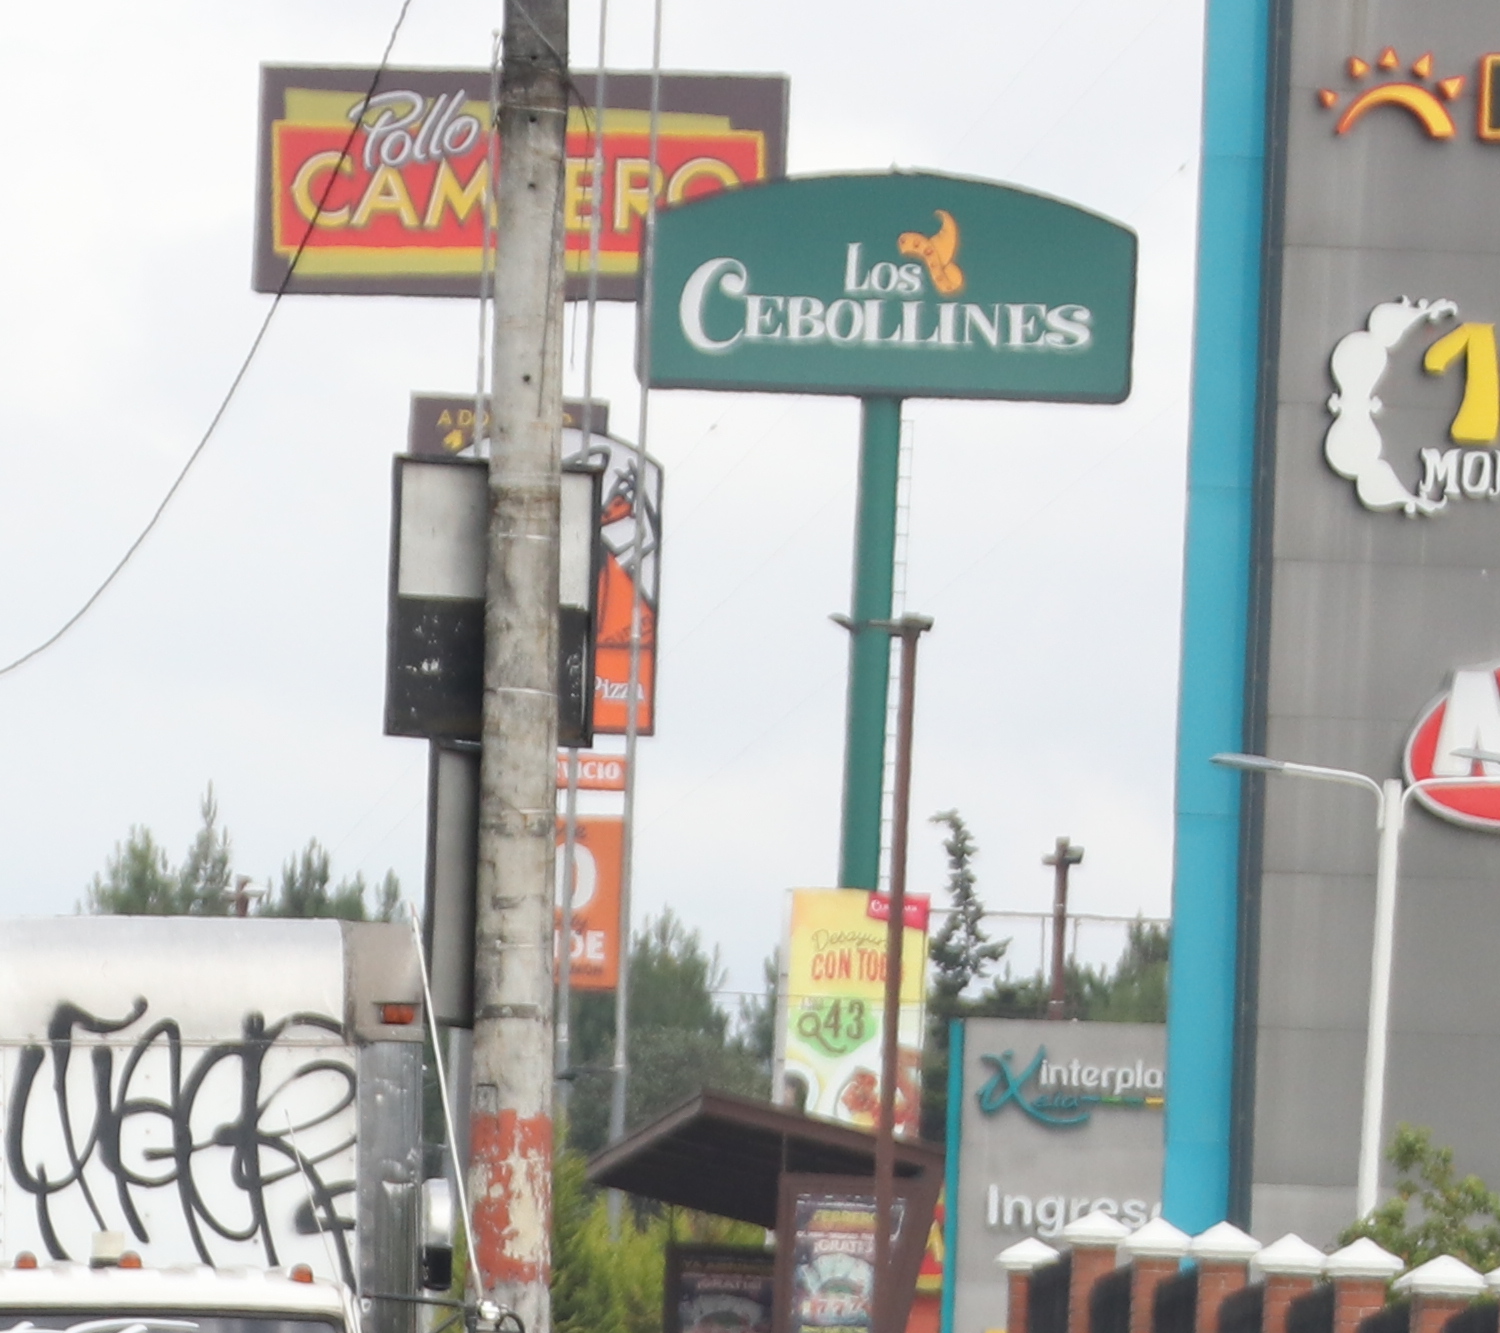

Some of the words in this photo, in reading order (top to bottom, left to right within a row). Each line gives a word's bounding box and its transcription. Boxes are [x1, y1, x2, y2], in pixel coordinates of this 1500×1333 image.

[347, 88, 481, 170] Pollo
[290, 152, 739, 234] CAMERO
[680, 256, 1093, 352] CEBOLLINES
[812, 949, 851, 980] CON
[858, 949, 903, 982] TOD
[1039, 1059, 1163, 1095] interpla
[987, 1184, 1163, 1238] Ingres
